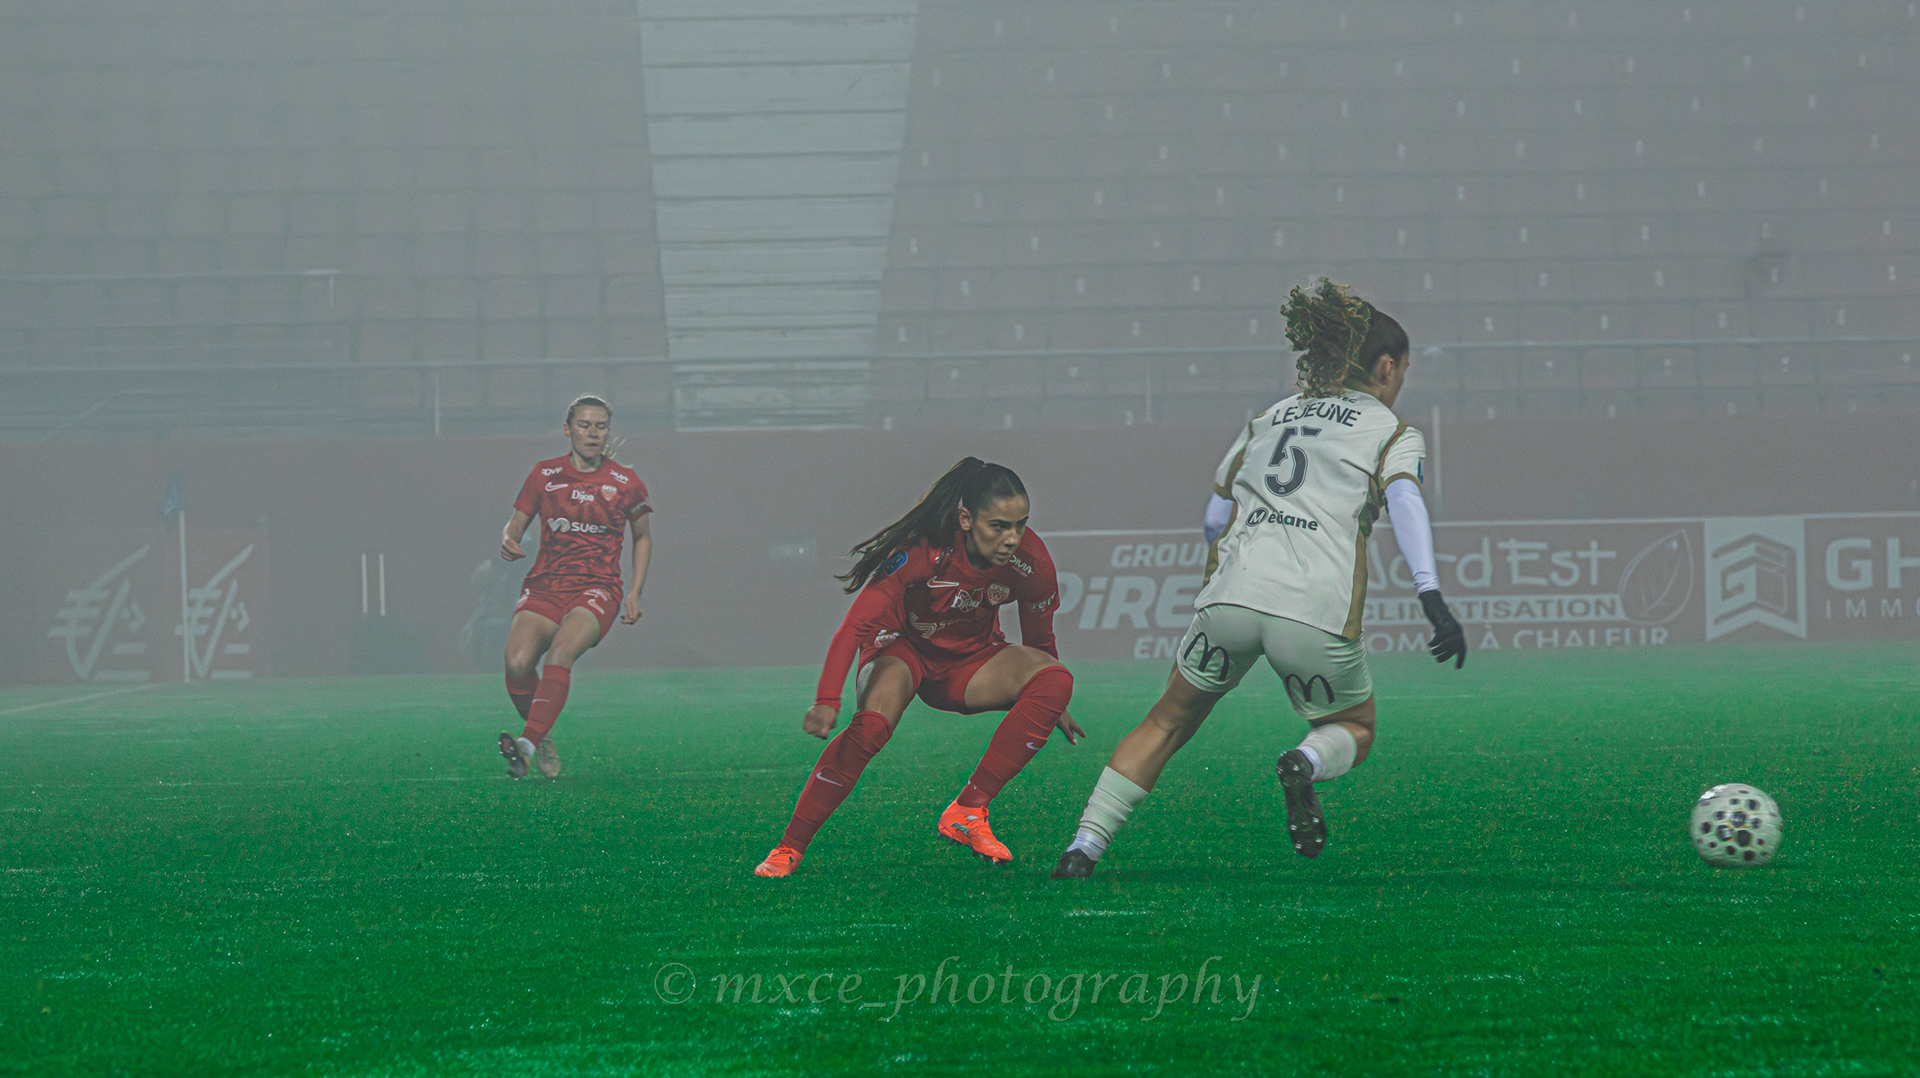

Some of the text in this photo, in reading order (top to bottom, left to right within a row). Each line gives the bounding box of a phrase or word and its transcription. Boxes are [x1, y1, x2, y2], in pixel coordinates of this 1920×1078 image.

[1272, 402, 1361, 427] LEJEUNE
[1264, 426, 1322, 497] 5
[1110, 542, 1206, 568] GROU
[1497, 537, 1617, 587] Est
[1825, 598, 1920, 621] IMM
